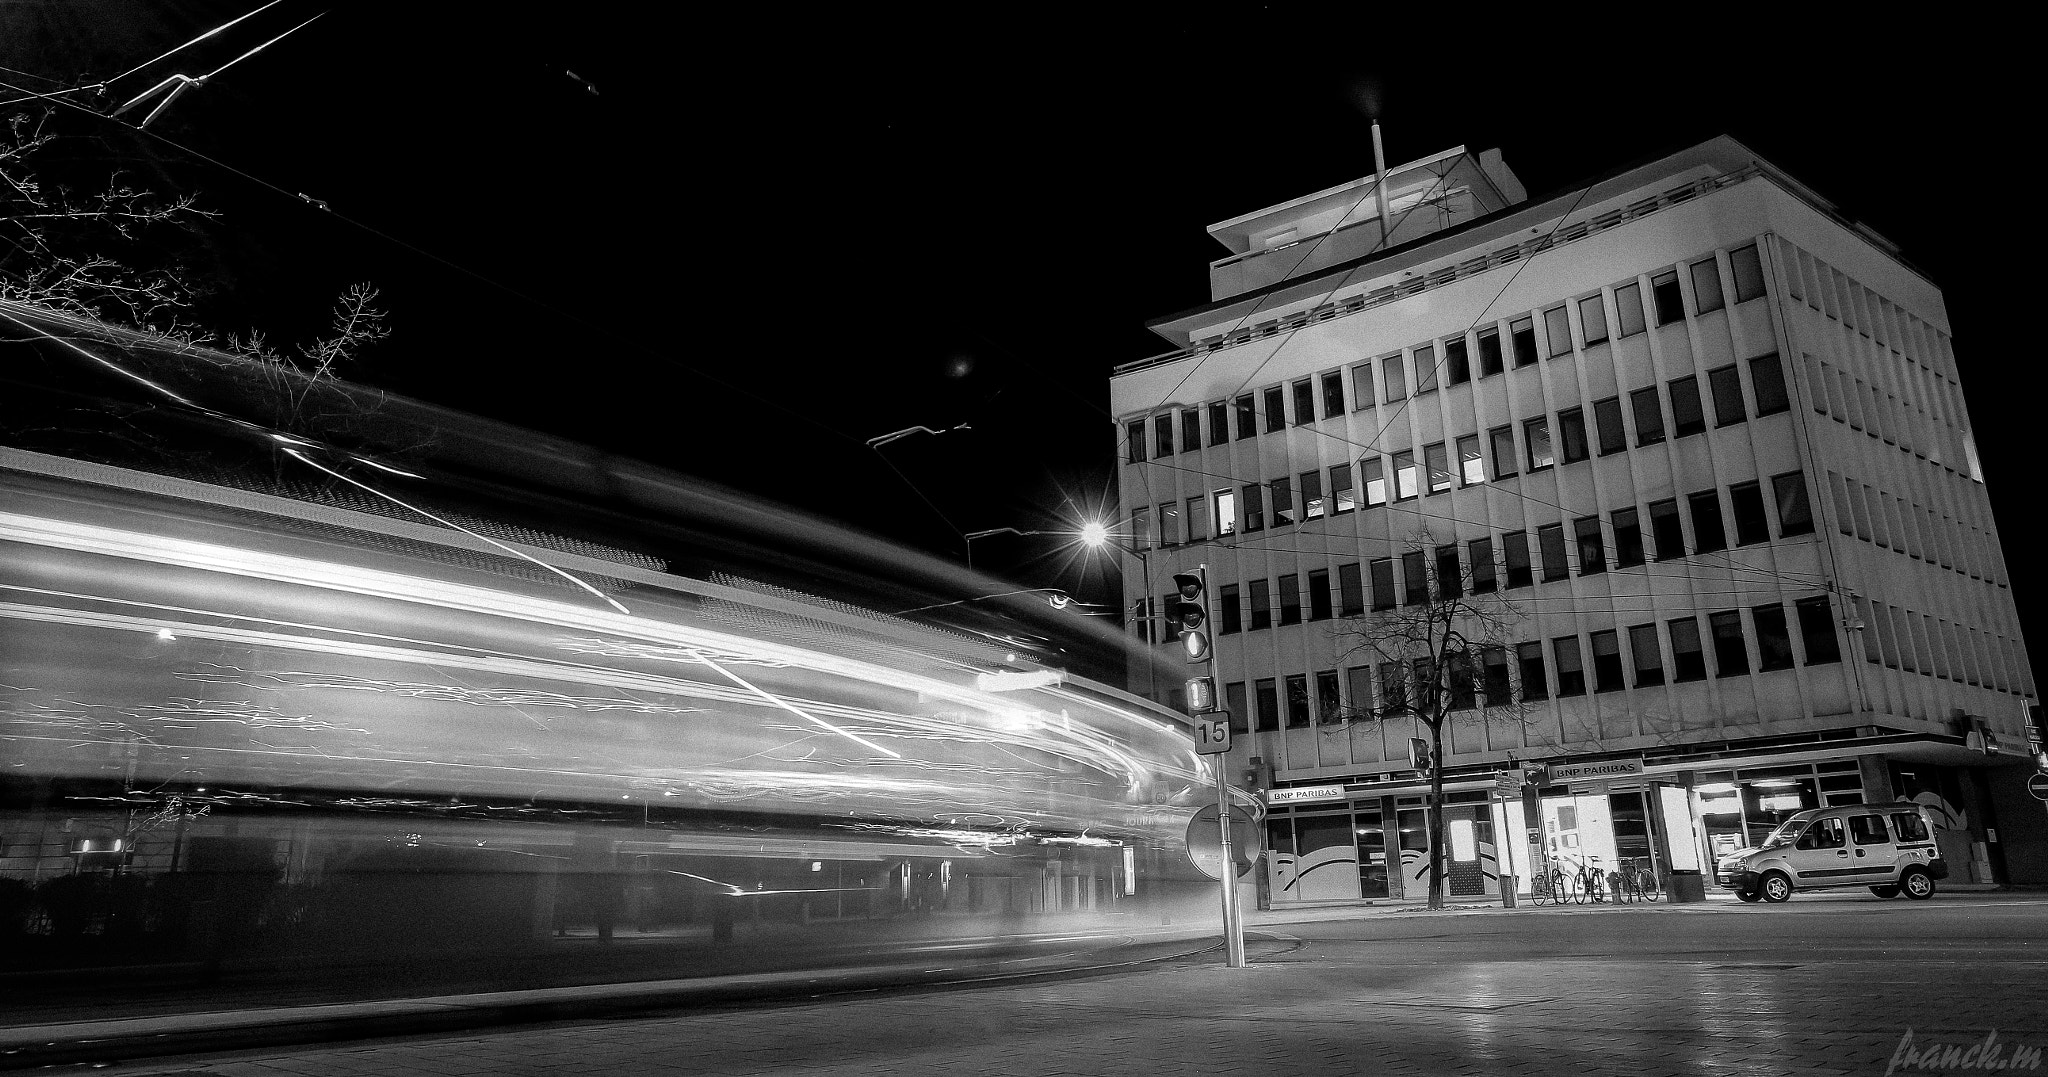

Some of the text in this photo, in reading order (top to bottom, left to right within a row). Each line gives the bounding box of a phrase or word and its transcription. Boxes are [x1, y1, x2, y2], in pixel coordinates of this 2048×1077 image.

[1198, 721, 1226, 744] 15
[1556, 763, 1635, 777] BNP PARIBAS
[1274, 788, 1338, 800] BNP PARIBAS
